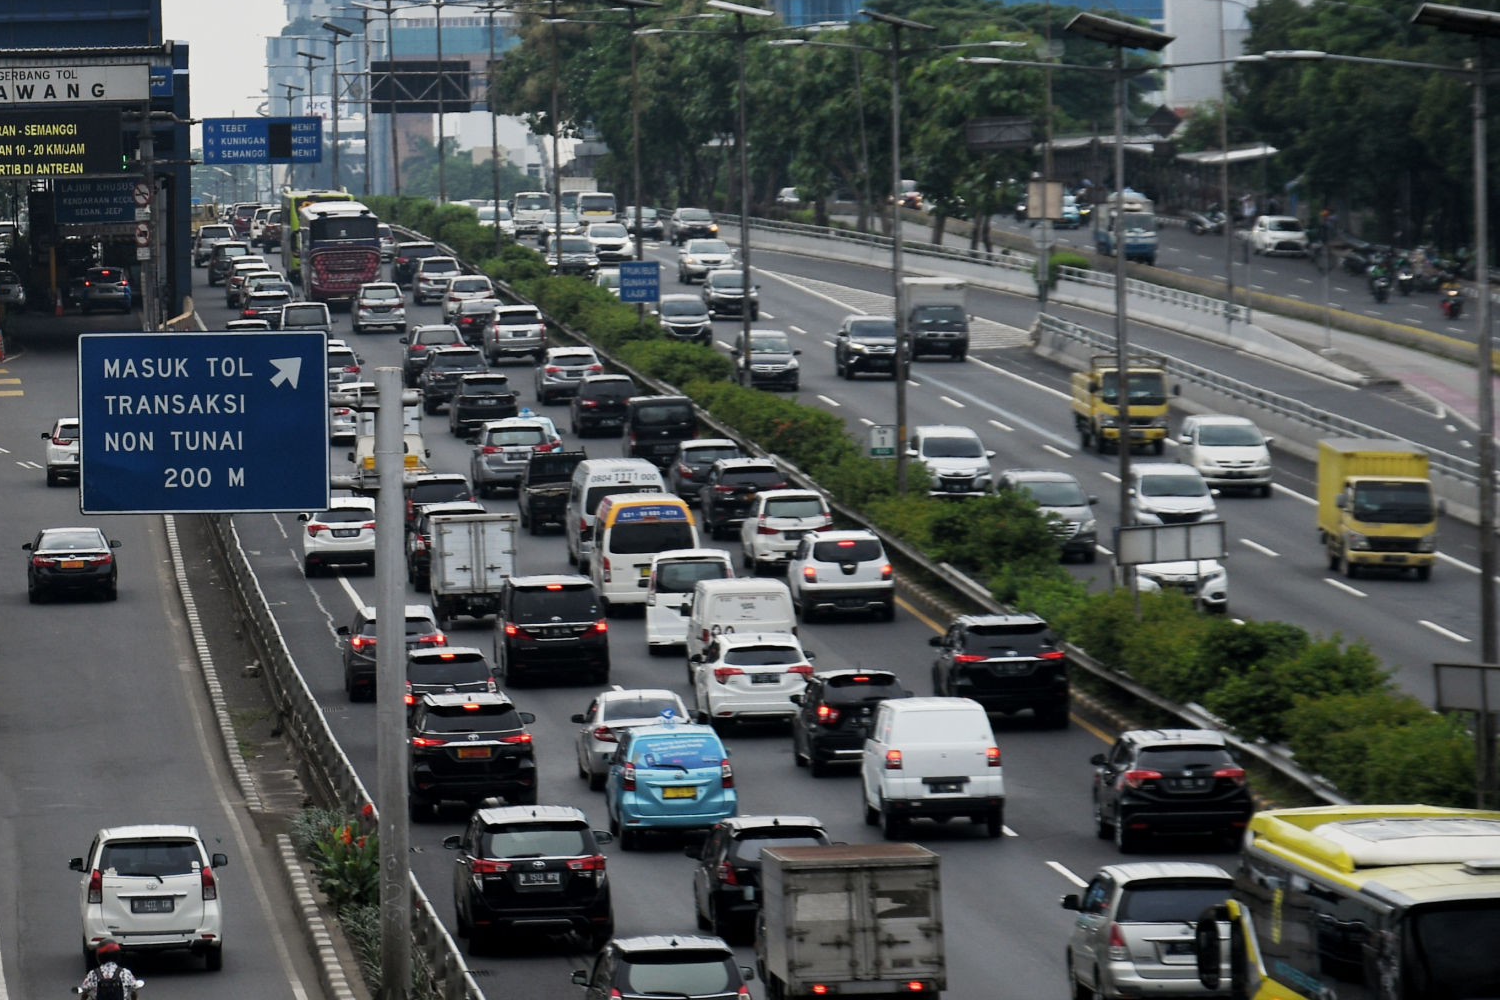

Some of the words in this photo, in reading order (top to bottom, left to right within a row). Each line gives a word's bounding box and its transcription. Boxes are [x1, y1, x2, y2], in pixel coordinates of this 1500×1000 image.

[57, 69, 78, 80] TOL
[24, 124, 77, 136] SEMANGGI
[220, 124, 247, 133] TEBET
[291, 123, 316, 132] MENIT
[220, 136, 266, 145] KUNINGAN
[291, 136, 316, 144] MENIT
[15, 145, 26, 156] 10
[33, 144, 44, 155] 20
[46, 143, 85, 155] KM/JAM
[221, 149, 266, 158] SEMANGGI
[291, 149, 316, 157] MENIT
[23, 163, 33, 175] DI
[36, 163, 83, 175] ANTREAN
[103, 358, 189, 378] MASUK
[206, 357, 253, 378] TOL
[104, 394, 245, 415] TRANSAKSI
[104, 432, 154, 452] NON
[170, 431, 243, 451] TUNAI
[164, 468, 212, 488] 200
[228, 467, 245, 487] M
